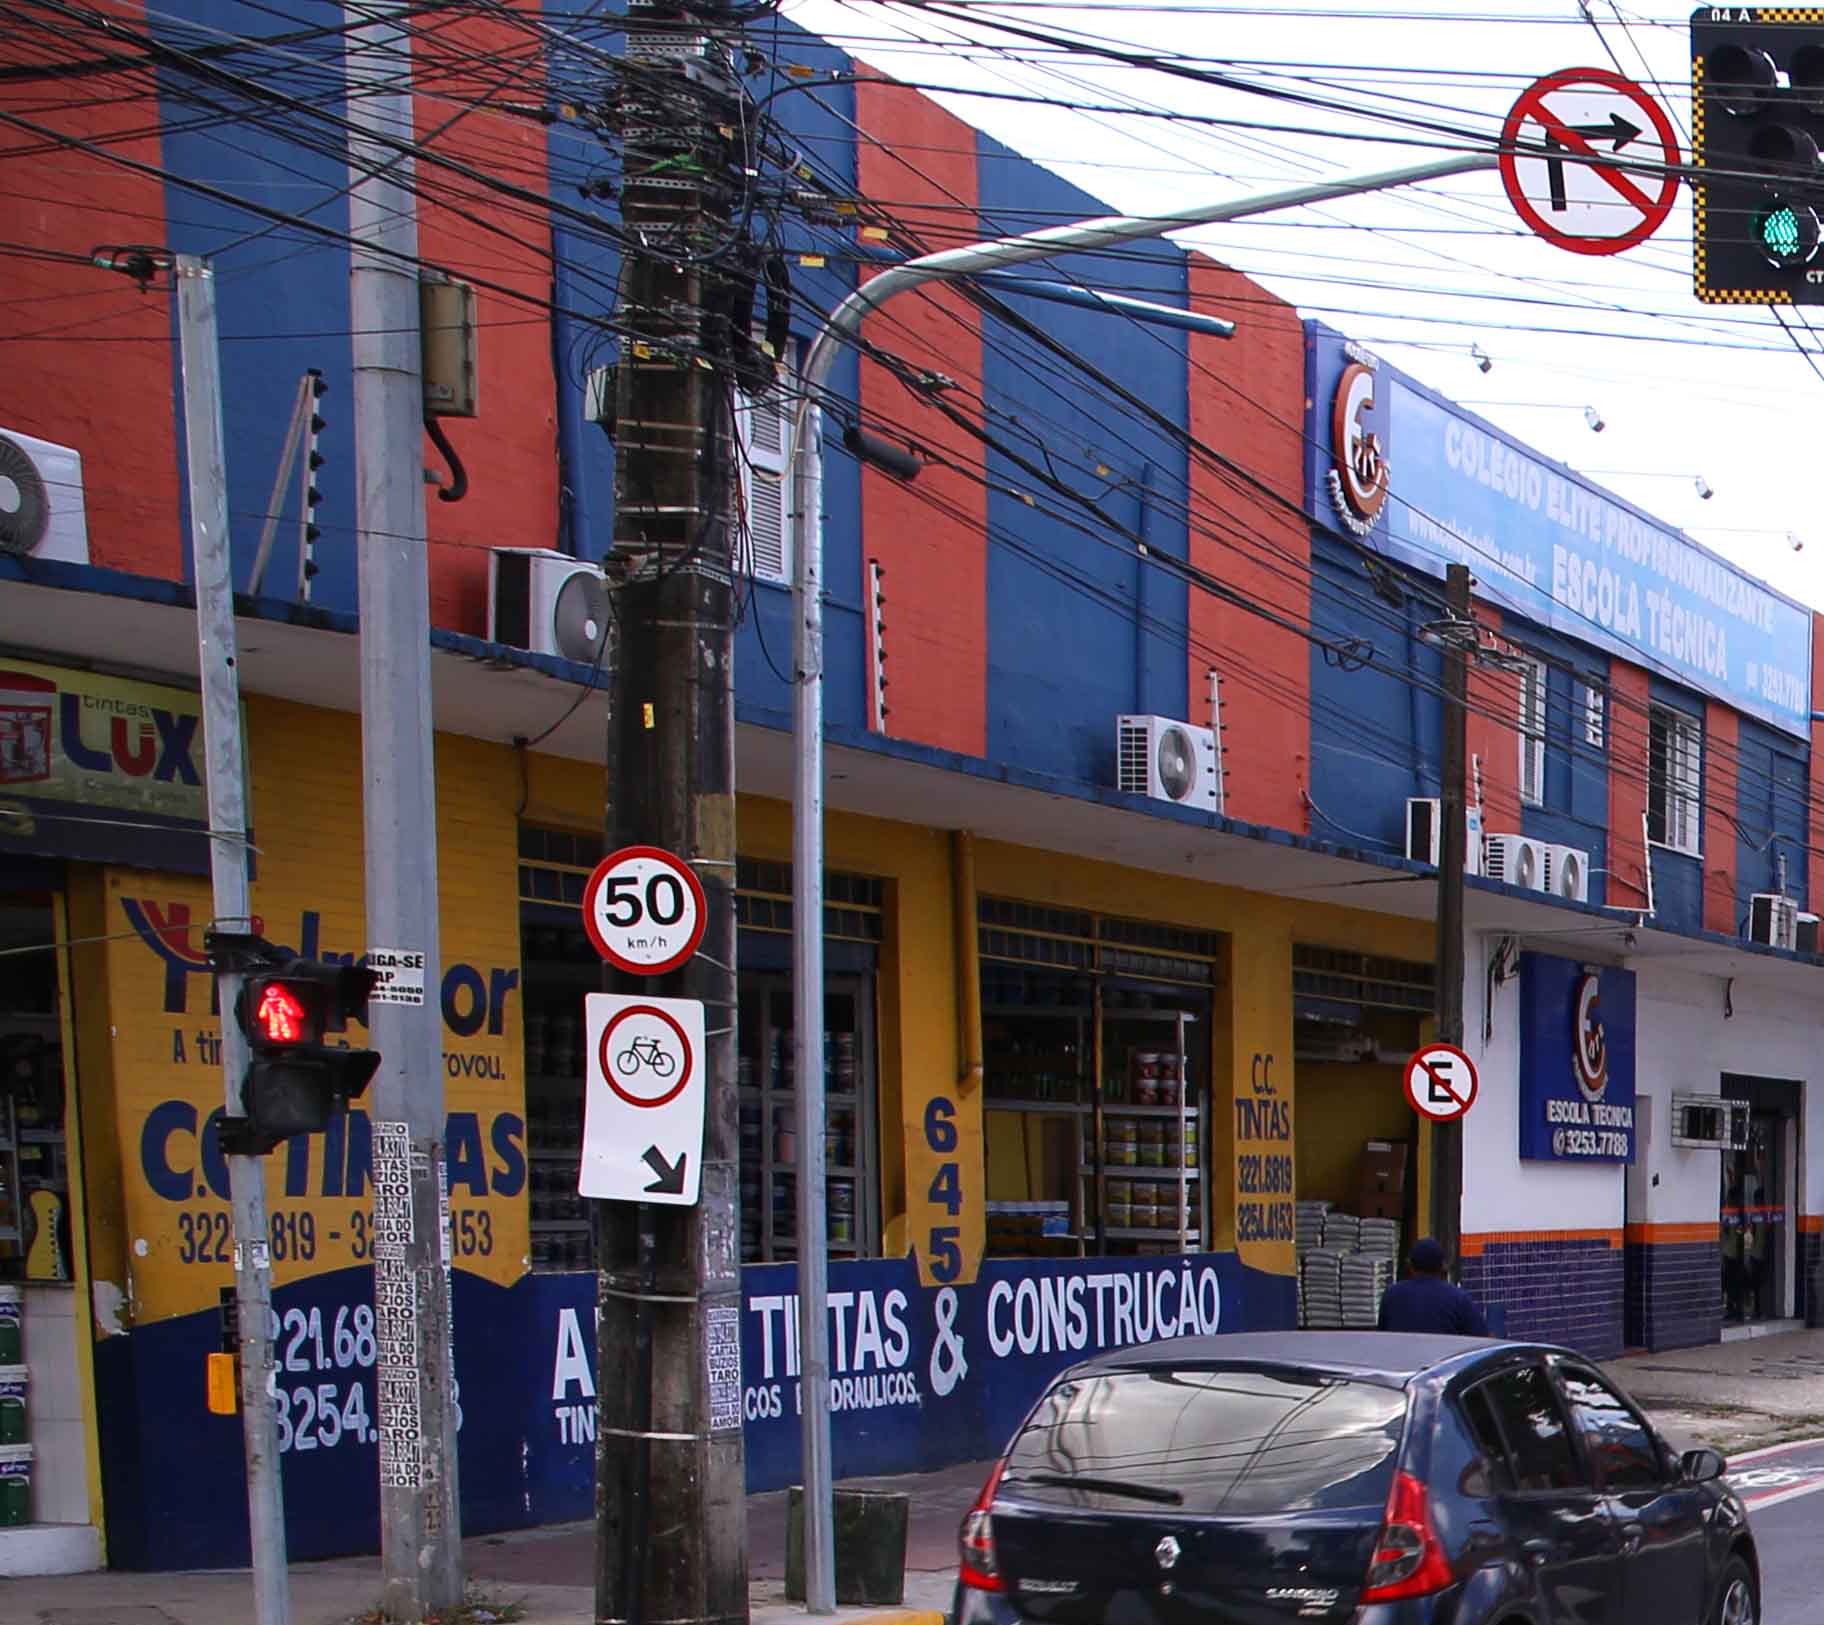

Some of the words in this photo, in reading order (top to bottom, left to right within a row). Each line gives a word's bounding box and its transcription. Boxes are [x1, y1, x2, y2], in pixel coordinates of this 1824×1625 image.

[1738, 8, 1751, 22] A
[1546, 476, 1601, 541] ELITE
[1552, 543, 1641, 640] ESCOLA
[1647, 588, 1729, 680] TÉCNICA
[83, 694, 150, 718] tintas
[604, 872, 686, 928] 50
[626, 935, 668, 950] km/h
[1252, 1052, 1277, 1095] C.C.
[1427, 1061, 1455, 1104] E
[1235, 1097, 1291, 1141] TINTAS
[1546, 1099, 1590, 1125] ESCOLA
[749, 1288, 910, 1379] TITAS
[929, 1286, 969, 1398] &
[711, 1369, 739, 1381] TARO
[555, 1403, 600, 1445] TIN
